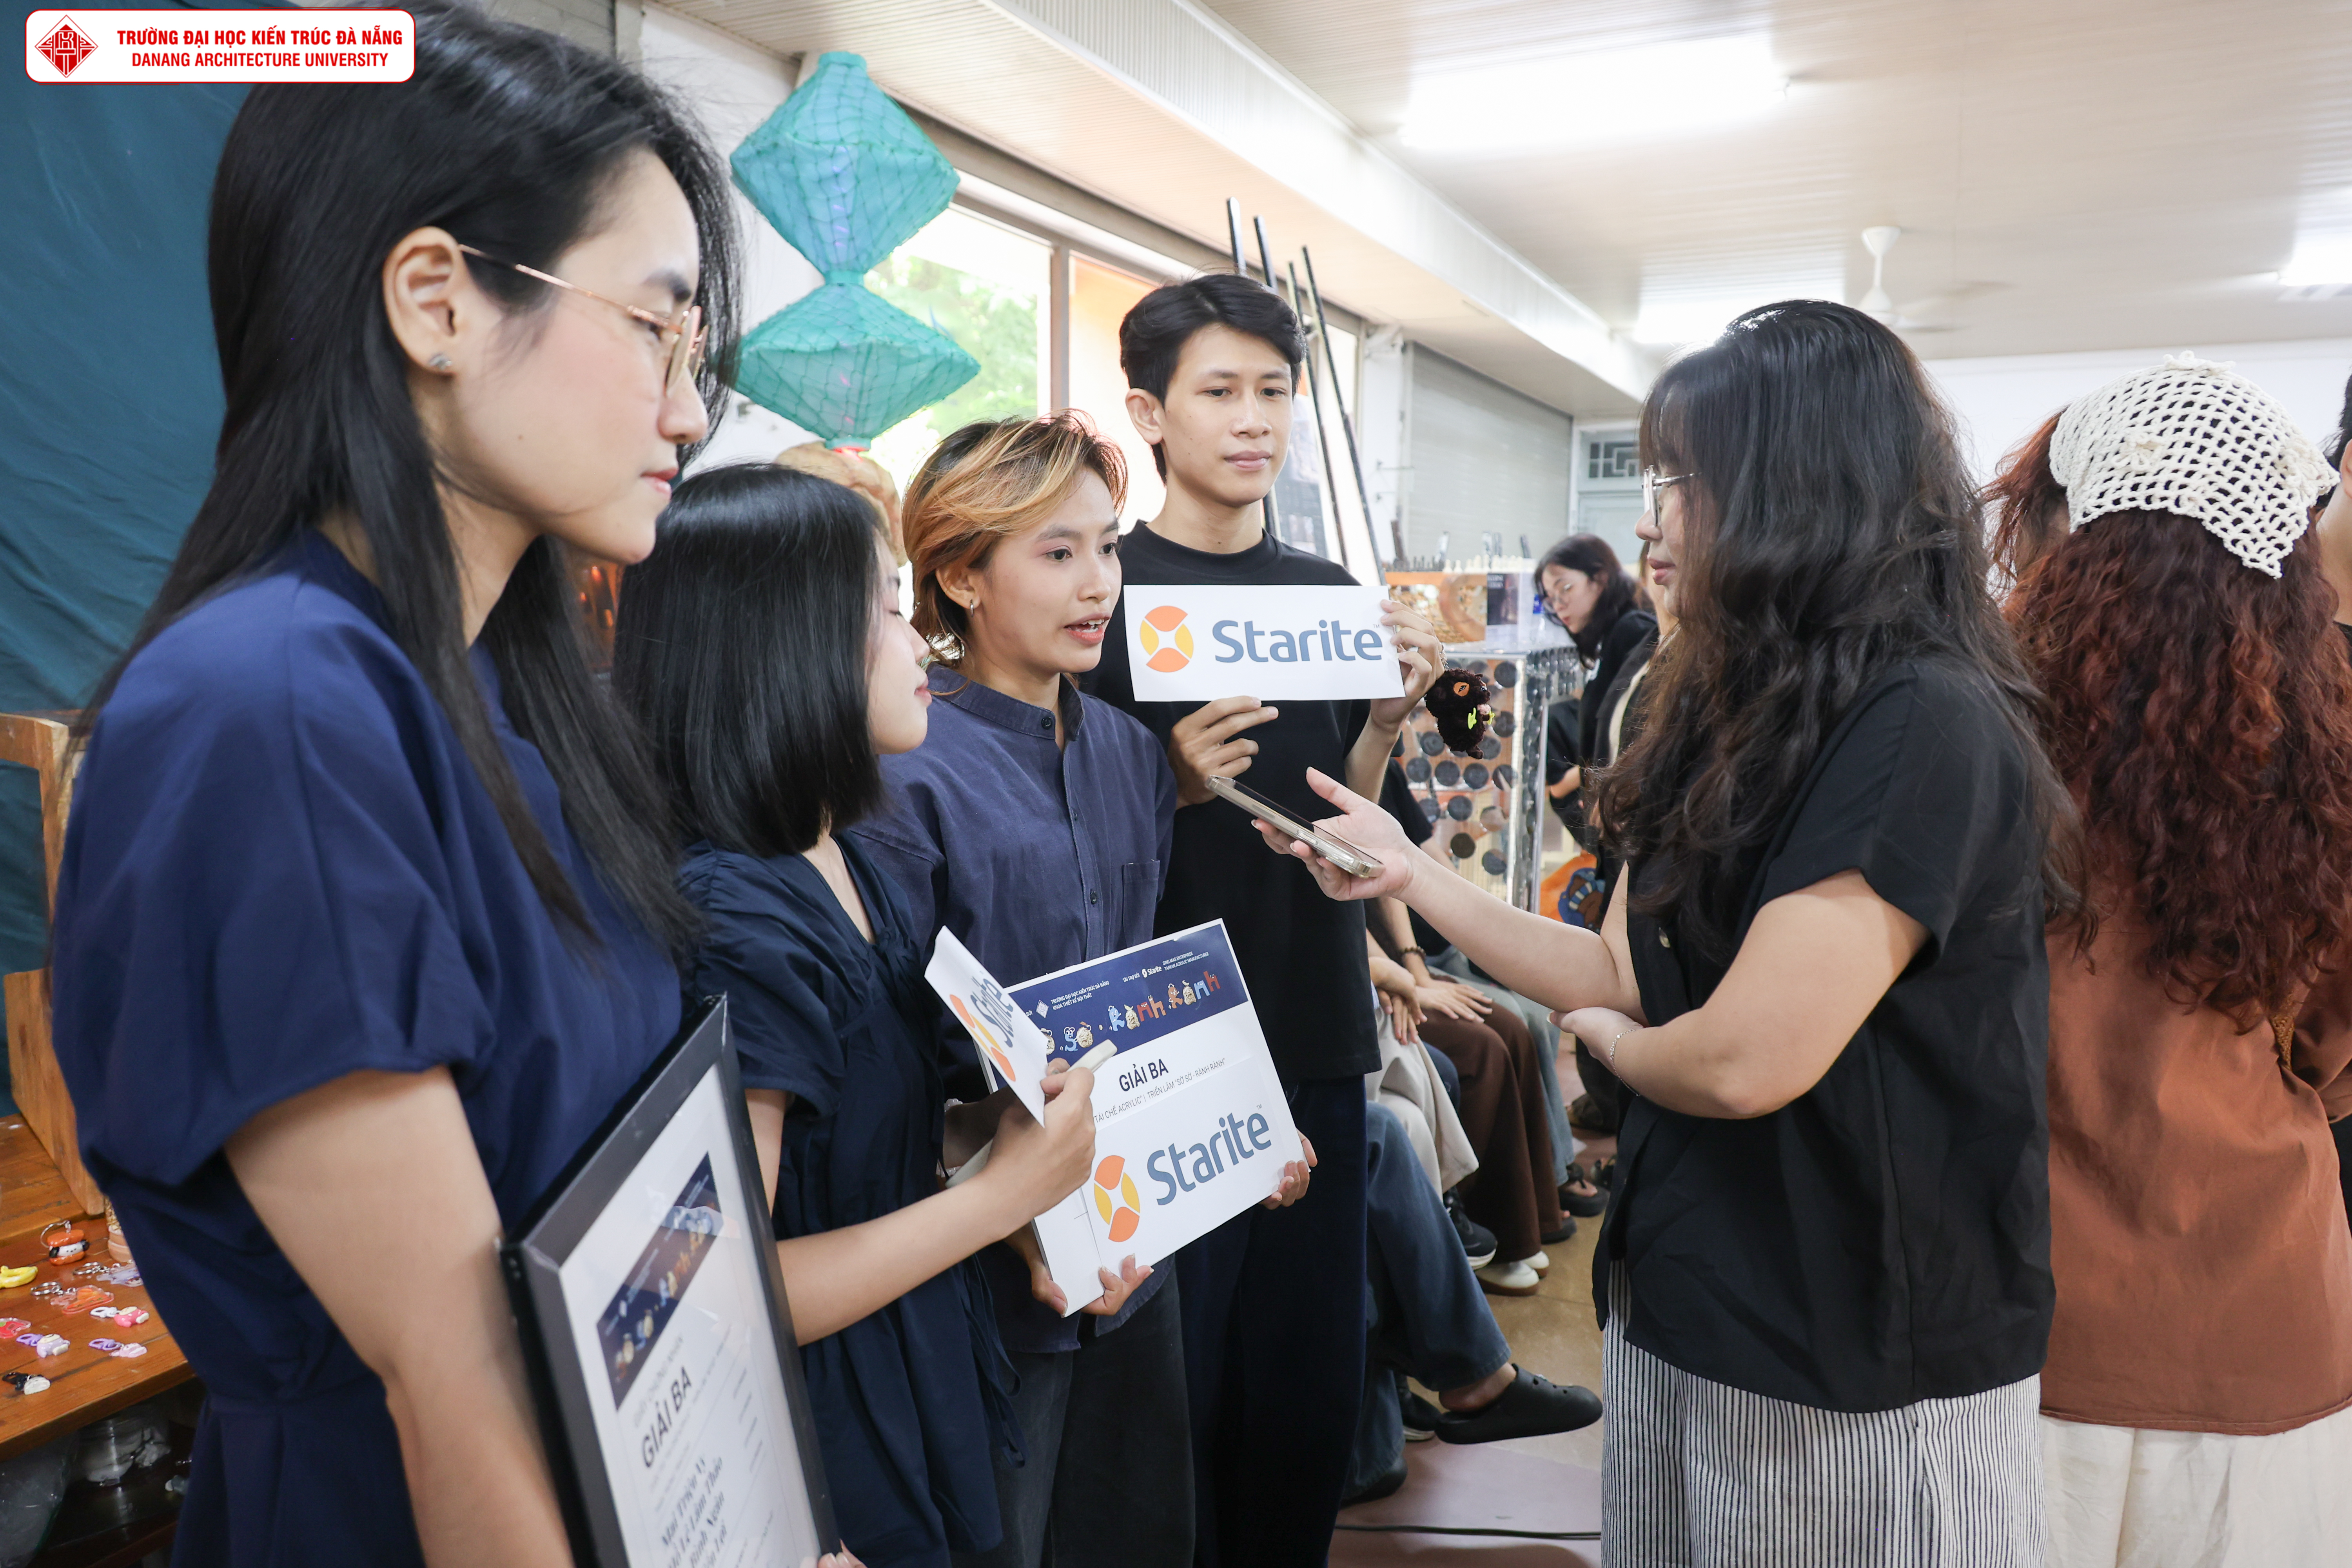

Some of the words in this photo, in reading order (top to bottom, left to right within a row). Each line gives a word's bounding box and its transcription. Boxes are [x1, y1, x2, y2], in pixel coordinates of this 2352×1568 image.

[1212, 619, 1383, 663] Starite
[1176, 951, 1194, 960] ENTERPRISE
[1187, 952, 1209, 963] MANUFACTURER
[1147, 965, 1162, 975] Starite
[1051, 996, 1065, 1005] TRƯỜNG
[1062, 998, 1073, 1007] THIẾT
[1119, 1063, 1148, 1092] GIẢI
[1148, 1058, 1169, 1080] BA
[1094, 1112, 1104, 1123] TÁI
[1105, 1105, 1118, 1119] CHẾ
[1147, 1086, 1163, 1100] TRIỂN
[1163, 1081, 1175, 1093] LÃM
[1185, 1072, 1192, 1083] SỜ
[1195, 1065, 1210, 1078] RÀNH
[1147, 1112, 1272, 1206] Starite
[641, 1399, 672, 1468] GIẢI
[671, 1367, 691, 1412] BA
